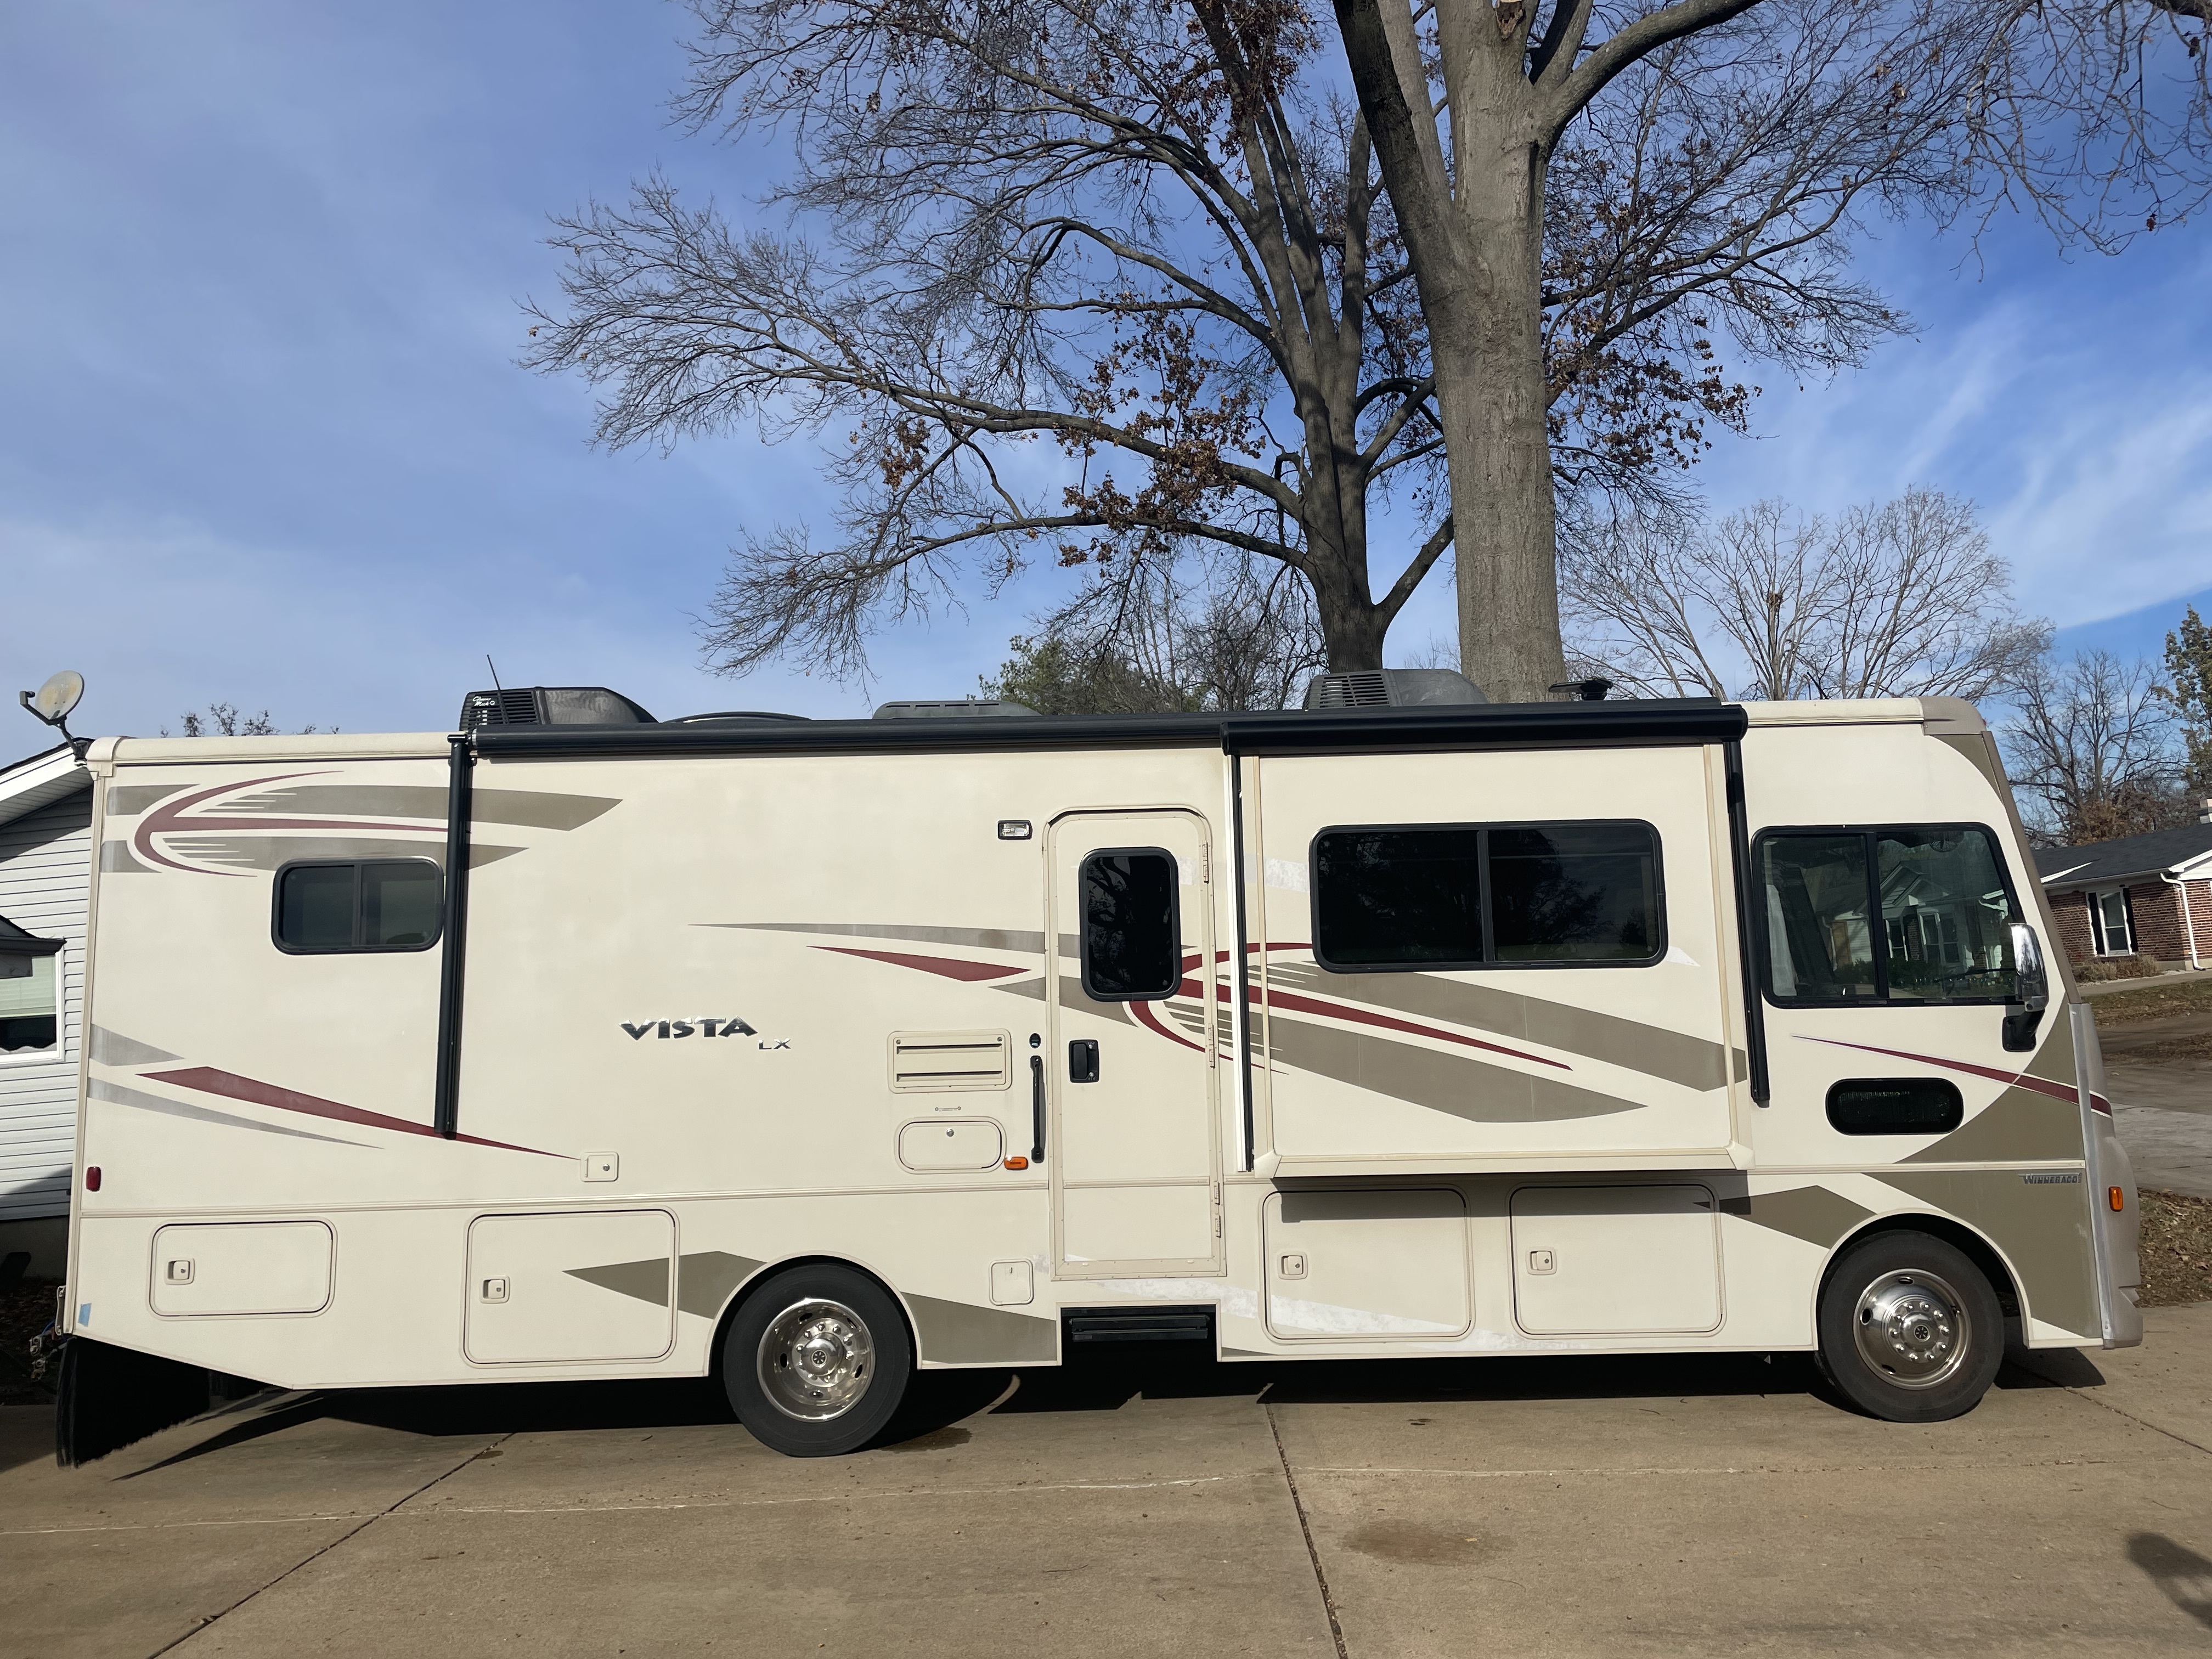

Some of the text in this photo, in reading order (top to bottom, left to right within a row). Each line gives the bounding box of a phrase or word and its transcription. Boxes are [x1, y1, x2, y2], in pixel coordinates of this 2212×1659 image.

[618, 1016, 791, 1050] VISTA LX
[2021, 1173, 2078, 1184] WINNEBAGO
